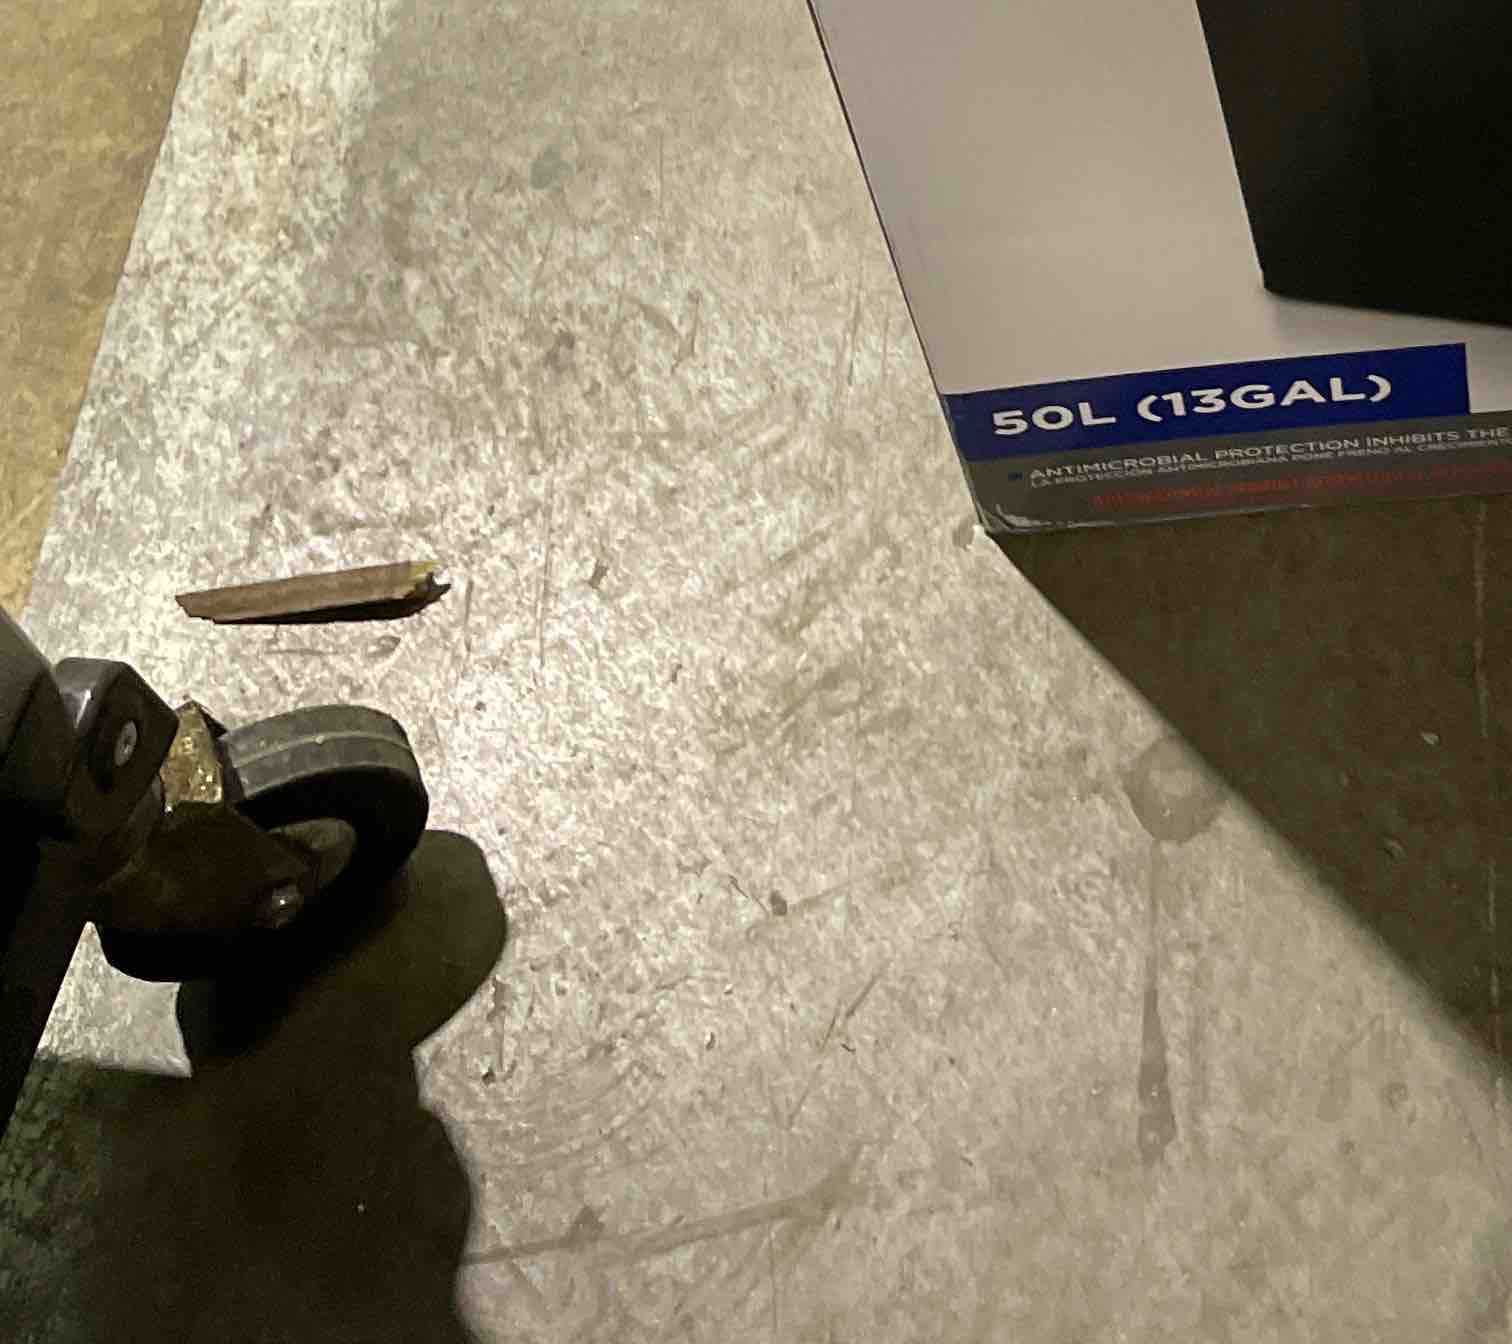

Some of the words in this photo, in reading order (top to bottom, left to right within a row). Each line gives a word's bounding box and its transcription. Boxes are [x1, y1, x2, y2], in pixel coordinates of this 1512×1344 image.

[993, 406, 1116, 436] 50L
[1136, 374, 1392, 423] (13GAL)
[1030, 453, 1208, 478] ANTIMICROBIAL
[1215, 438, 1360, 460] PROTECTION
[1366, 431, 1460, 448] INHIBITS
[1466, 426, 1509, 439] THE
